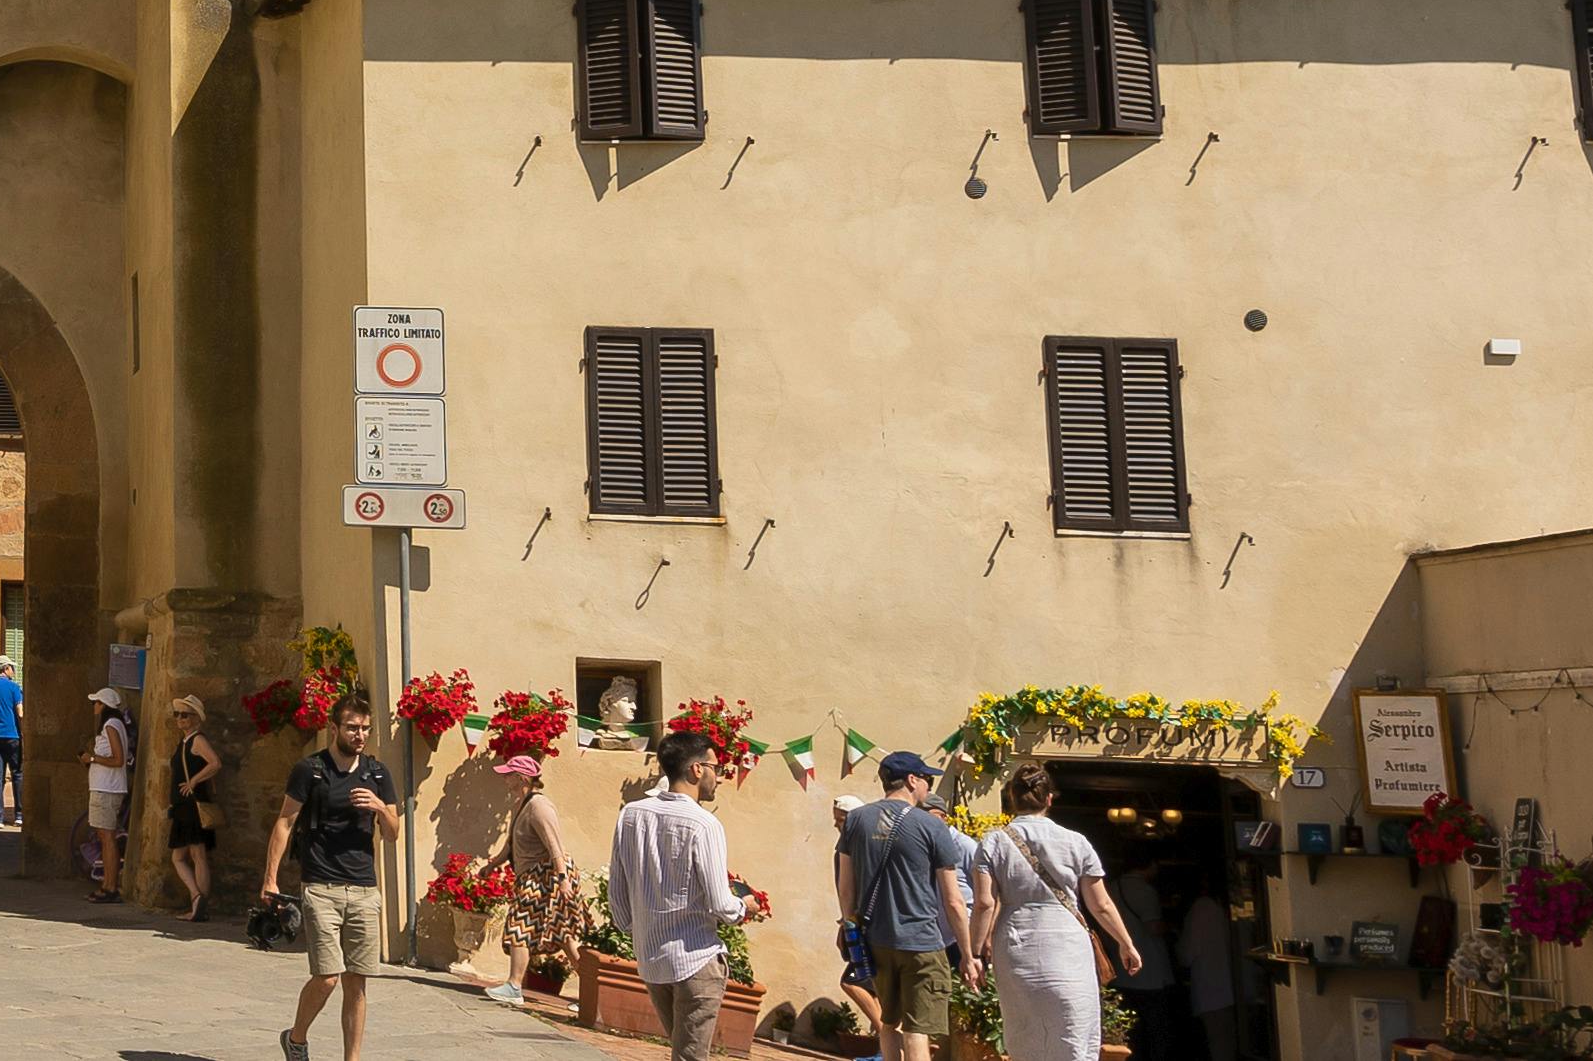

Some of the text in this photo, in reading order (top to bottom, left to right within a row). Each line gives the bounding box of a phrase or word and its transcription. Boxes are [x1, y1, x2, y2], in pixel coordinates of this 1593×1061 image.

[387, 313, 411, 324] ZONA
[358, 327, 441, 339] TRAFFICO LIMITATO
[1376, 708, 1422, 717] Alessandro
[1050, 725, 1232, 747] PROFUMI
[1367, 719, 1435, 742] Serpico
[1384, 760, 1427, 773] Artista
[1298, 770, 1315, 786] 17
[1374, 778, 1441, 792] Profumiere
[1358, 927, 1395, 936] Perfumes
[1359, 944, 1395, 952] produced
